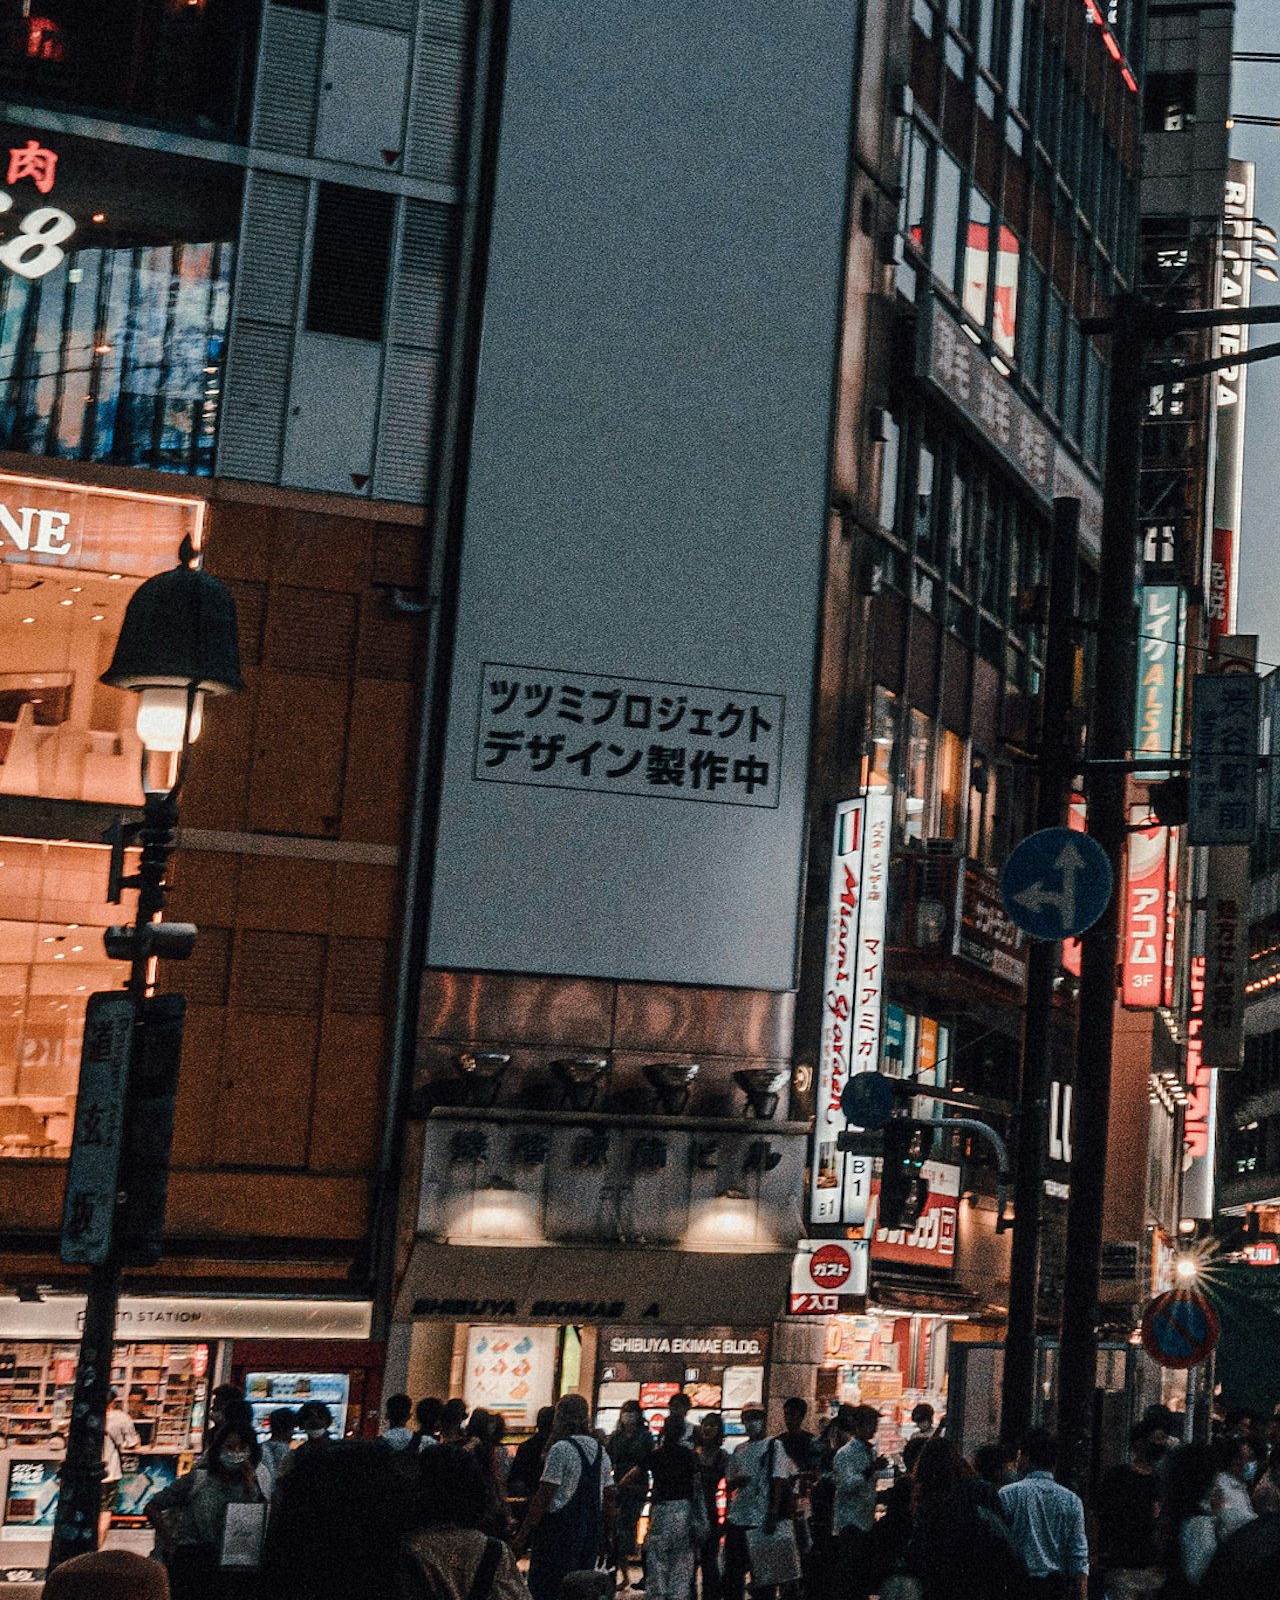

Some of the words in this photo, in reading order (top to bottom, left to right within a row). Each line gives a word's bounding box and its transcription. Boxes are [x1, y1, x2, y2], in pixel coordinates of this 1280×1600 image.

[5, 139, 59, 194] 肉
[1143, 593, 1172, 662] レイク
[489, 677, 773, 744] ツツミプロジェクト
[483, 730, 771, 795] デザイン製作中
[1220, 687, 1250, 831] 渋谷駅前
[1129, 886, 1160, 965] アコム
[1131, 974, 1154, 989] 3F
[812, 1263, 850, 1278] ガスト
[137, 1311, 203, 1324] STATION
[807, 1295, 839, 1311] 入口
[609, 1337, 671, 1353] SHIBUYA
[670, 1338, 722, 1354] EKIMAE
[721, 1339, 762, 1355] BLDG.
